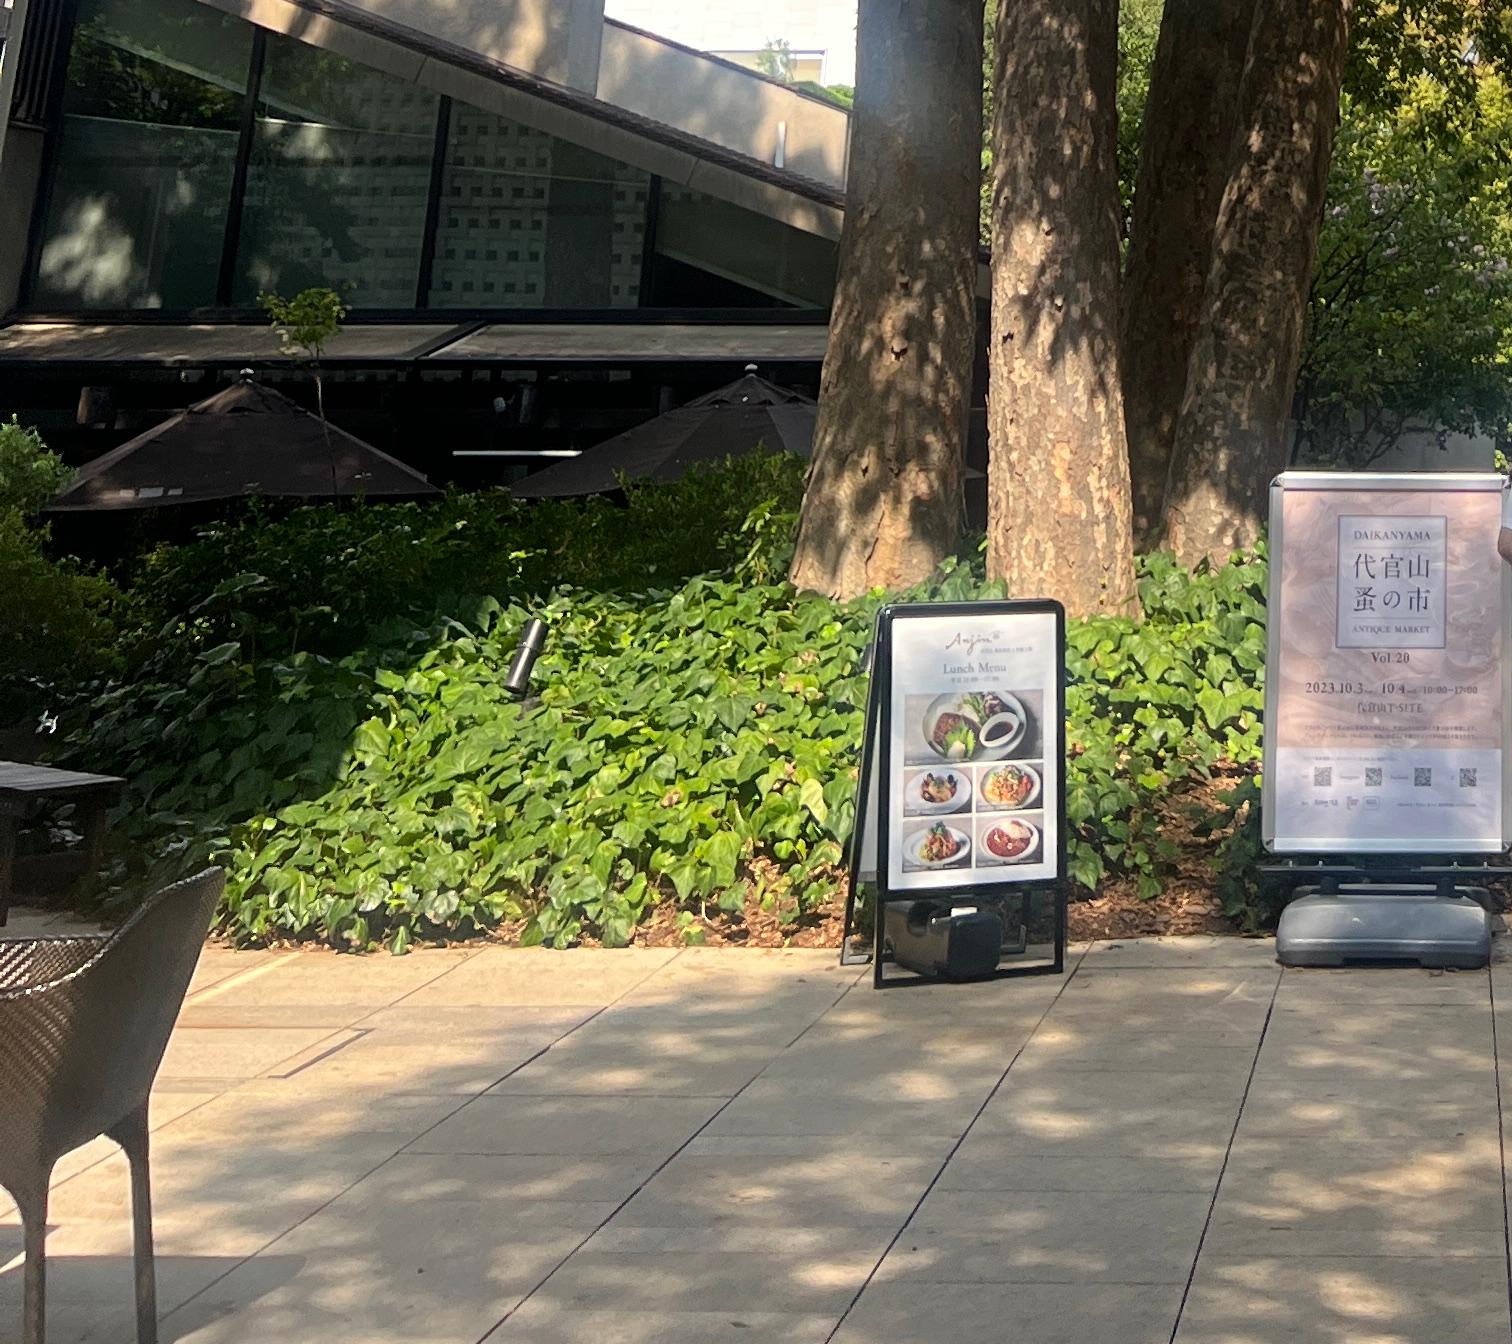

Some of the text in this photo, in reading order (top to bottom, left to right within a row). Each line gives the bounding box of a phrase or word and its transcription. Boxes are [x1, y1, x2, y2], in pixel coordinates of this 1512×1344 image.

[1353, 530, 1431, 540] DAIKANYAMA
[1354, 553, 1430, 579] 代官山
[1353, 586, 1431, 612] 蚤の市
[1353, 625, 1431, 634] ANTIQUE MARKET
[943, 661, 1007, 674] Lunch Menu
